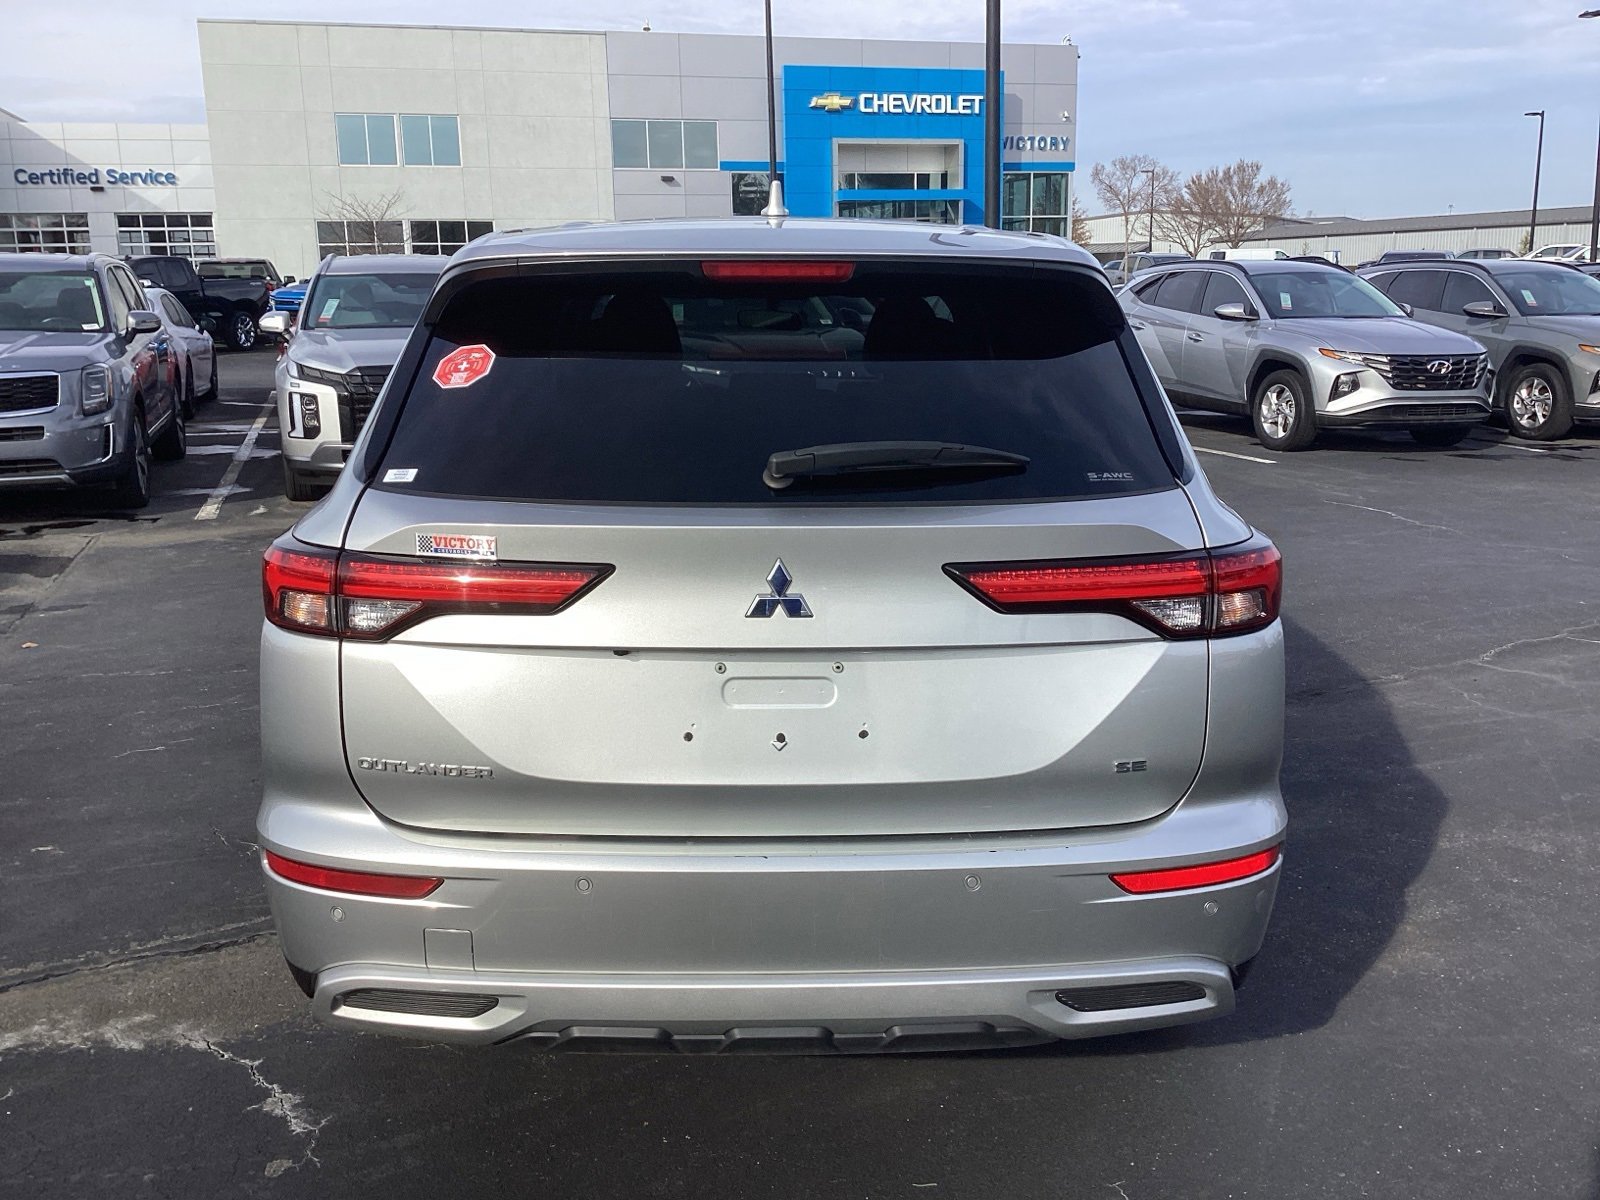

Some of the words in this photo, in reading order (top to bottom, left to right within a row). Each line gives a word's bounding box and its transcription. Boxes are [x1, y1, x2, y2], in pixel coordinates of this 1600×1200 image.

[859, 93, 984, 115] CHEVROLET
[14, 168, 99, 185] Certified
[106, 168, 178, 186] Service
[433, 536, 495, 550] VICTORY
[357, 757, 495, 779] OUTLANDER
[1114, 760, 1147, 774] SE
